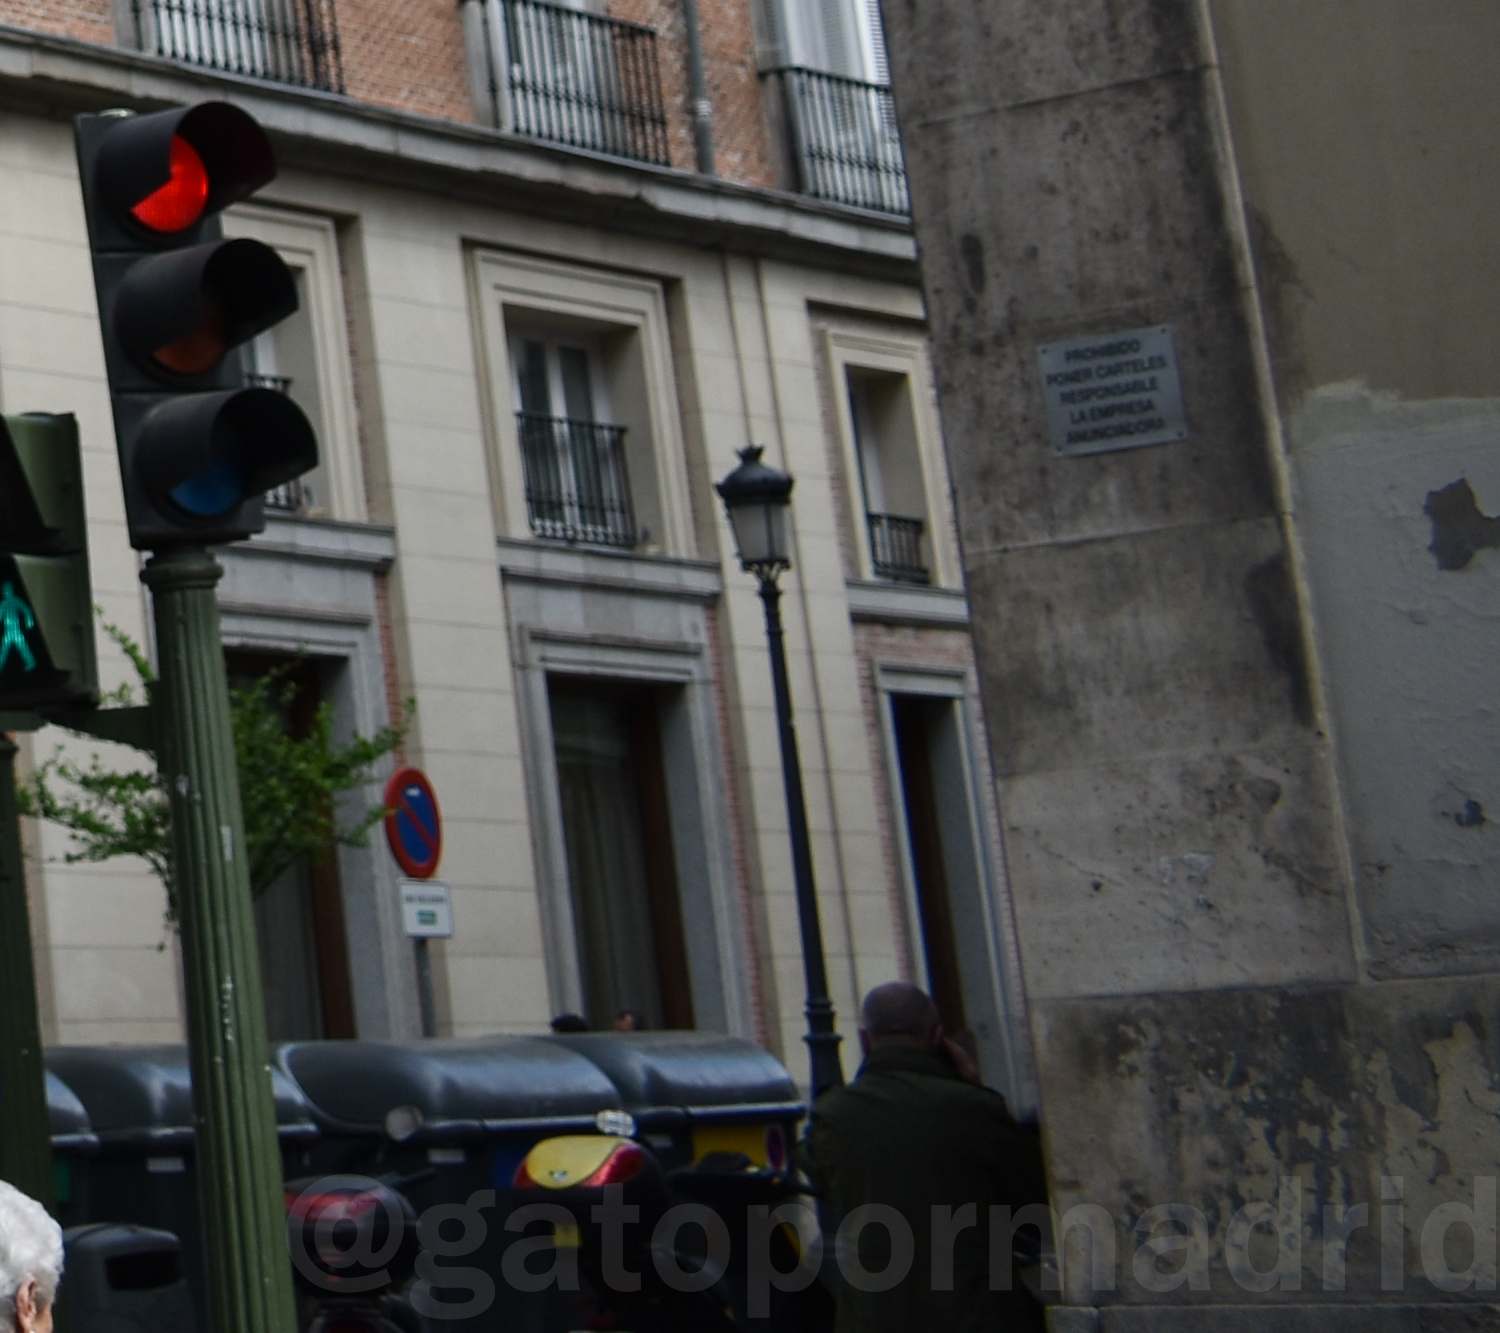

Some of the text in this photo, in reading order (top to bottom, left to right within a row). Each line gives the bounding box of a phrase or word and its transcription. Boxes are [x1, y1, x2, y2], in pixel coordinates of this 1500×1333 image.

[1064, 338, 1141, 362] PROHIBIDO
[1046, 354, 1168, 386] PONER CARTELES
[1059, 376, 1159, 404] RESPONSABLE
[1069, 398, 1156, 425] LA EMPRESA
[1066, 417, 1167, 444] ANUNCIADORA
